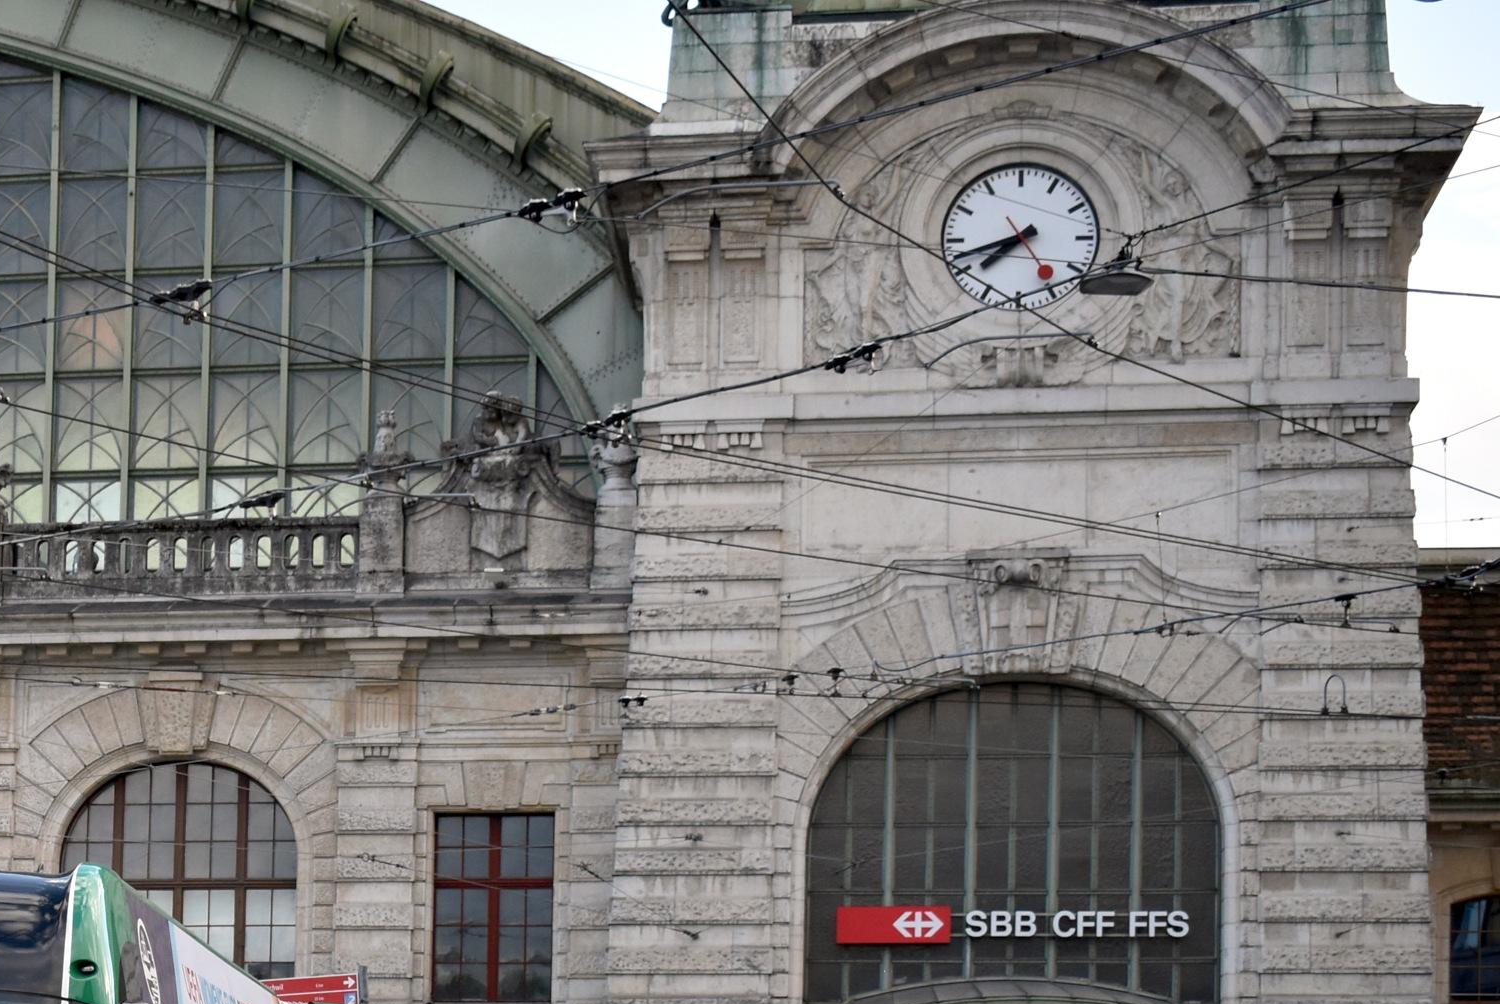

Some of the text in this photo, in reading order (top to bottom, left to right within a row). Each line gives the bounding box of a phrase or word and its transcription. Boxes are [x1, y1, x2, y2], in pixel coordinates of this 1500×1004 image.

[965, 910, 1190, 938] SBB CFF FFS
